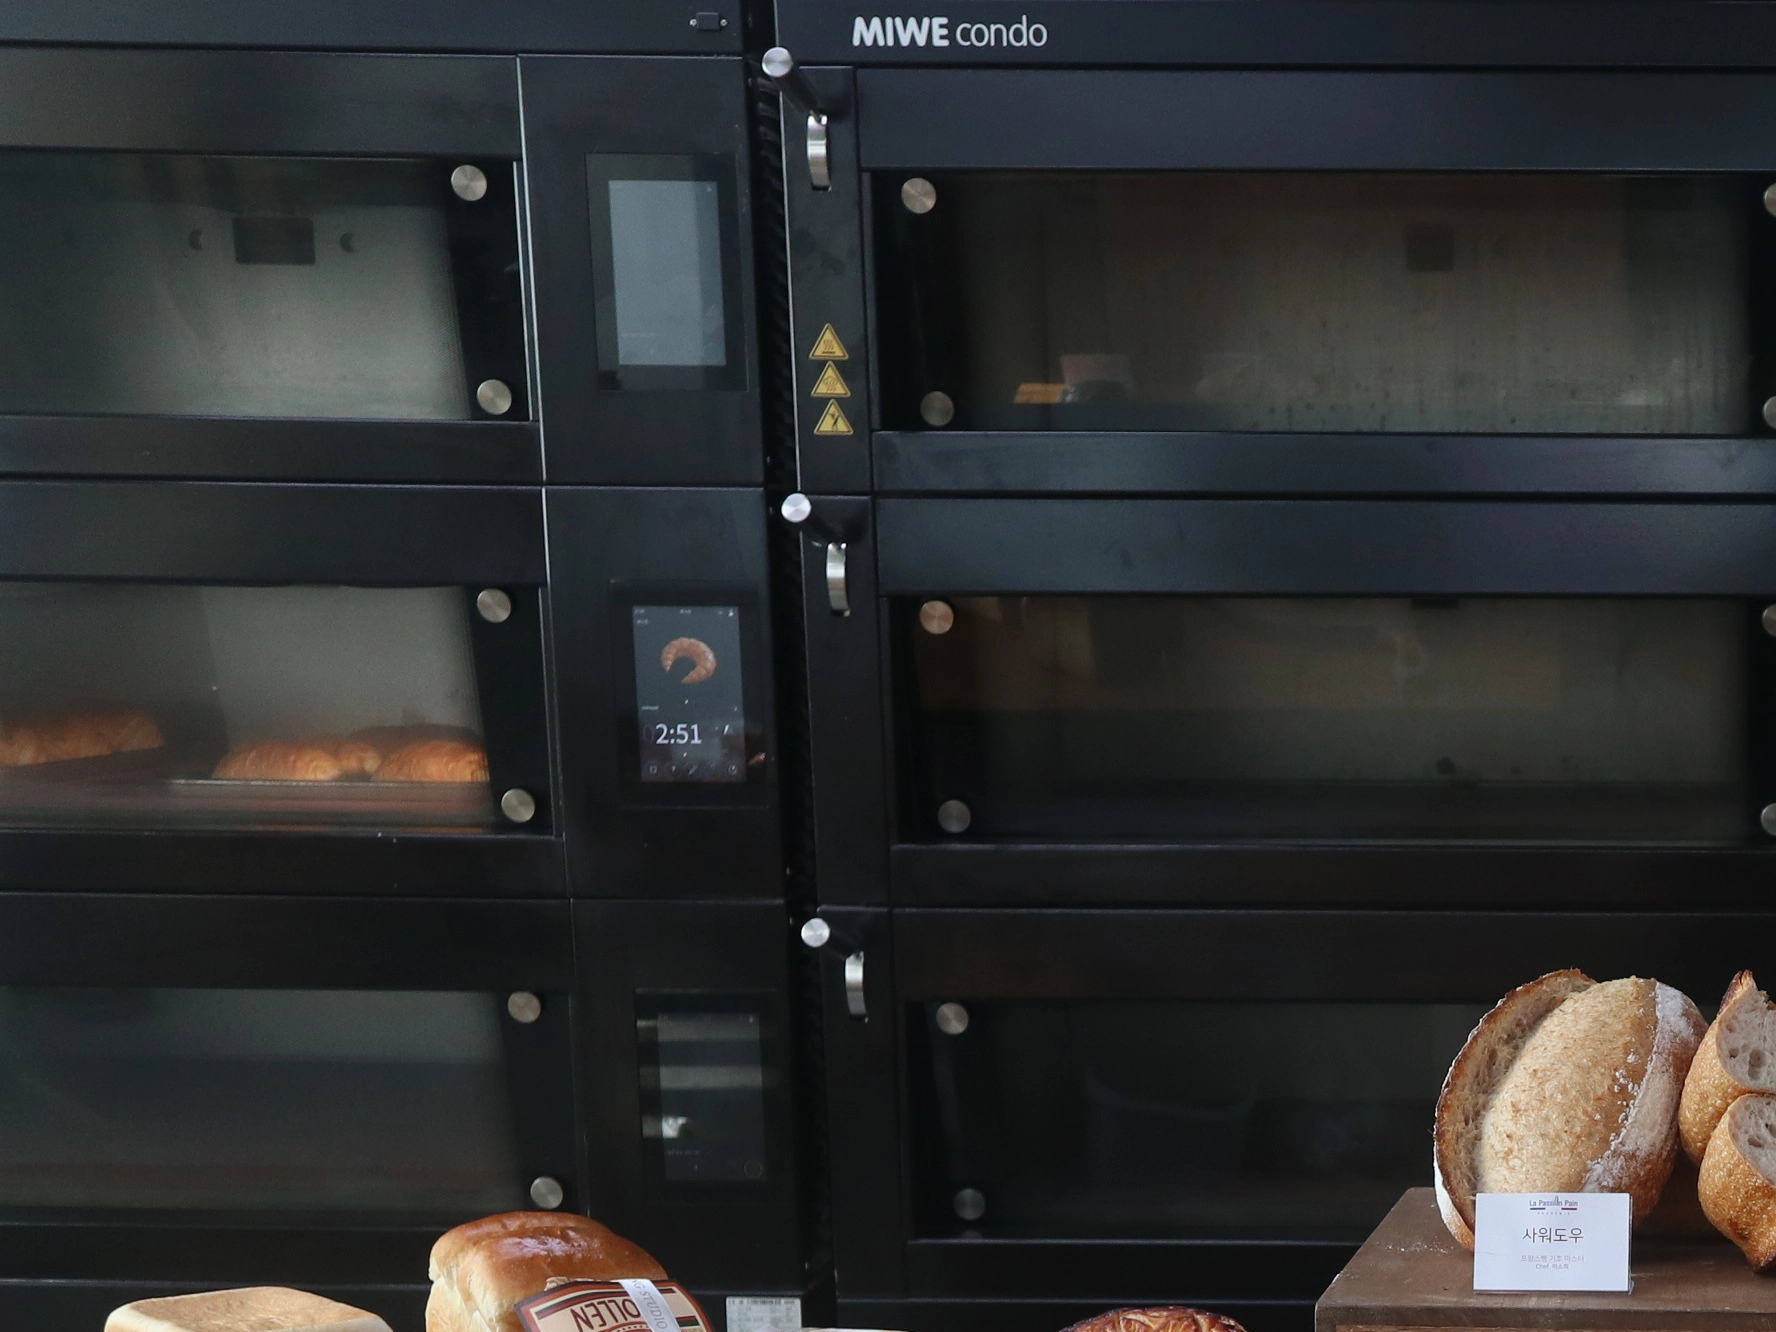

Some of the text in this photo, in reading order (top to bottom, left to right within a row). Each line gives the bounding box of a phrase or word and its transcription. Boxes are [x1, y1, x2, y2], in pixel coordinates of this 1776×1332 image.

[852, 14, 1048, 47] MIWE condo
[1539, 1196, 1563, 1207] Passion
[1522, 1227, 1584, 1244] 사워도우
[639, 1291, 669, 1330] STUDIO
